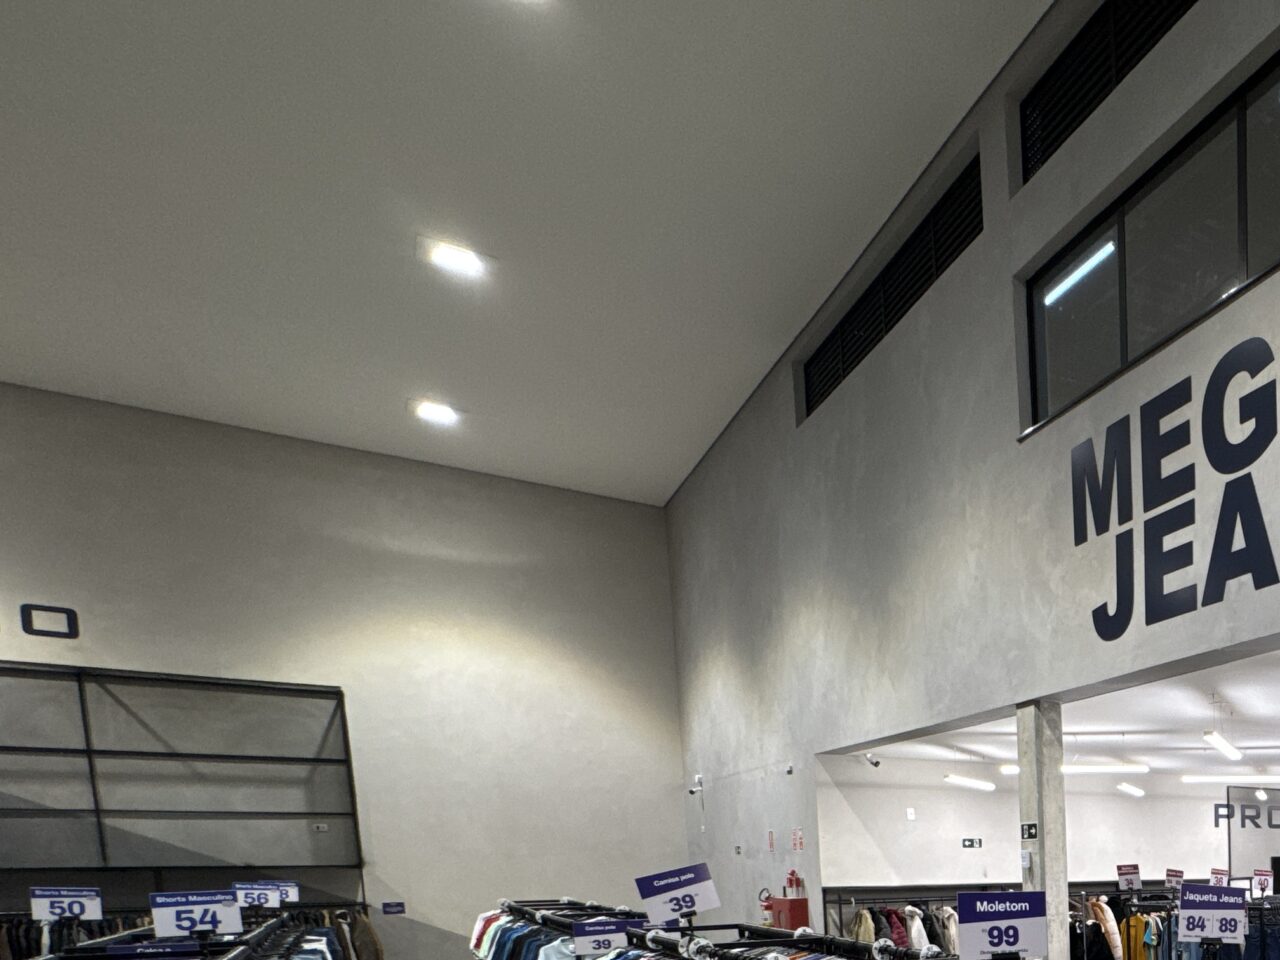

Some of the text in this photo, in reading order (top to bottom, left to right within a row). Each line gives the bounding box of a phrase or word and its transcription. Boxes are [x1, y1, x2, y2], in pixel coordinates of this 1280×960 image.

[653, 873, 695, 887] Camisa polo
[156, 894, 234, 903] Shorts Masculino
[244, 892, 269, 905] 56
[668, 893, 696, 913] 39
[1184, 891, 1243, 903] Jaqueta Jeans
[49, 901, 86, 917] 50
[976, 901, 1029, 912] Moletom
[175, 908, 221, 931] 54
[1186, 916, 1238, 933] 84 89
[988, 925, 1019, 947] 99
[592, 939, 611, 950] 39
